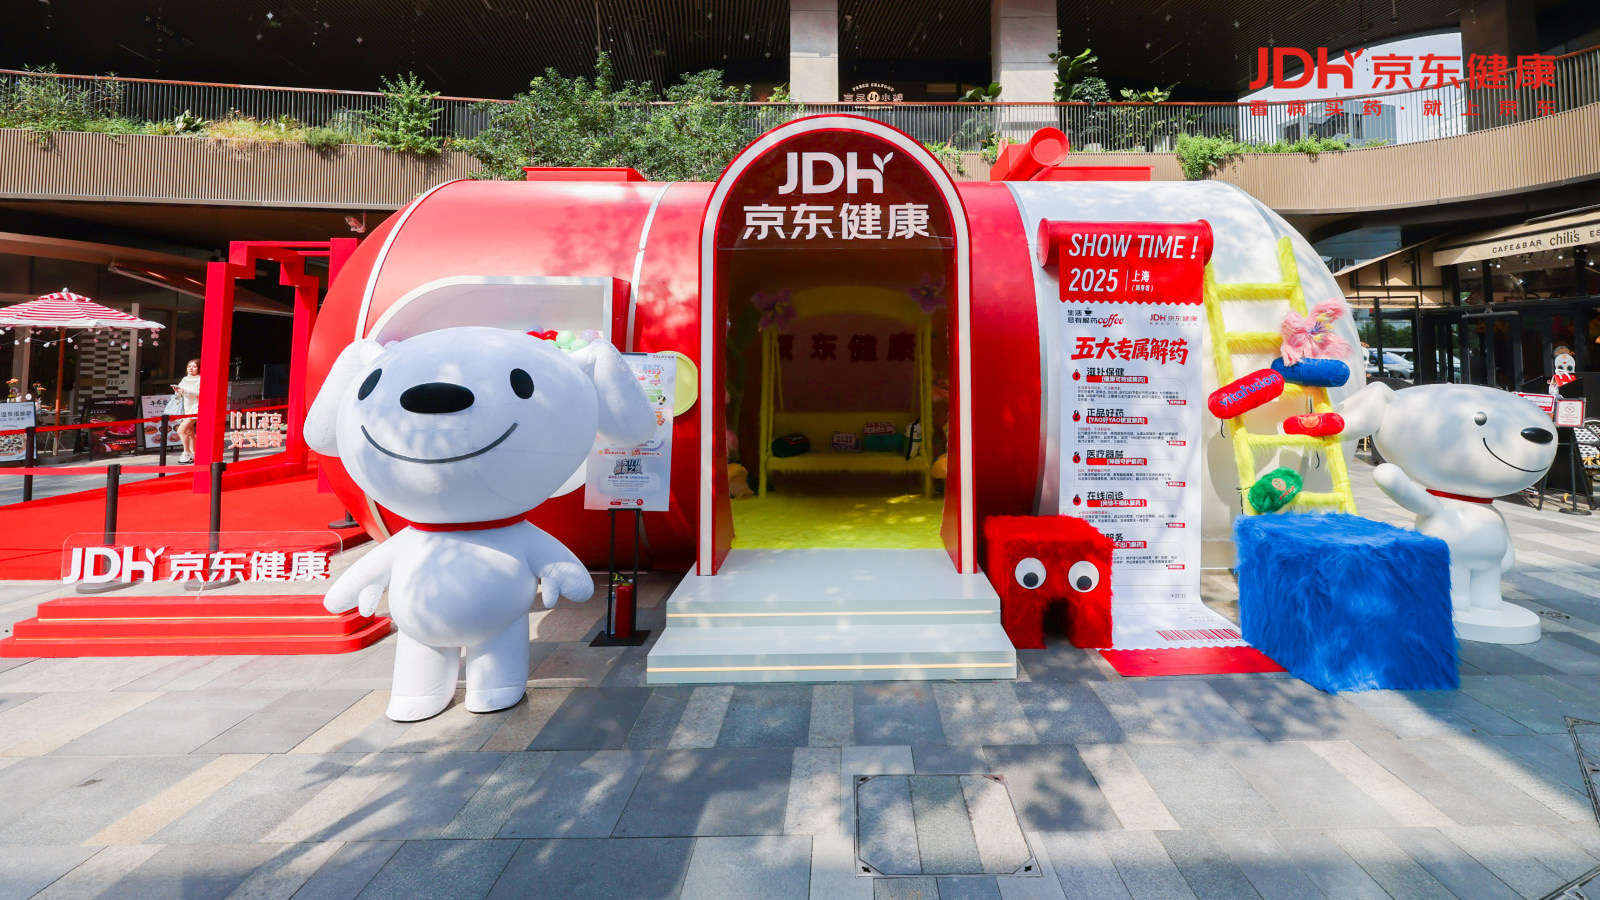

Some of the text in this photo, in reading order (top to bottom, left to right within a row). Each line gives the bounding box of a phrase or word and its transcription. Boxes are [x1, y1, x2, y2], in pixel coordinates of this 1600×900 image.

[778, 151, 894, 195] JDH
[742, 203, 930, 241] 京东健康
[1068, 233, 1132, 258] SHOW
[1137, 235, 1186, 259] TIME
[1492, 239, 1542, 254] CAFE&BAR
[1549, 229, 1580, 247] chili's
[1068, 267, 1151, 293] 2025 上海
[1067, 309, 1083, 317] 生活
[1097, 313, 1125, 328] coffee
[1070, 336, 1189, 365] 五大专属解药
[1086, 367, 1125, 377] 滋补保健
[1219, 373, 1279, 406] vitafusion
[1086, 408, 1125, 418] 正品好药
[1086, 449, 1124, 459] 医疗器械
[1086, 491, 1124, 501] 在线问诊
[62, 547, 332, 584] JDH 京东健康
